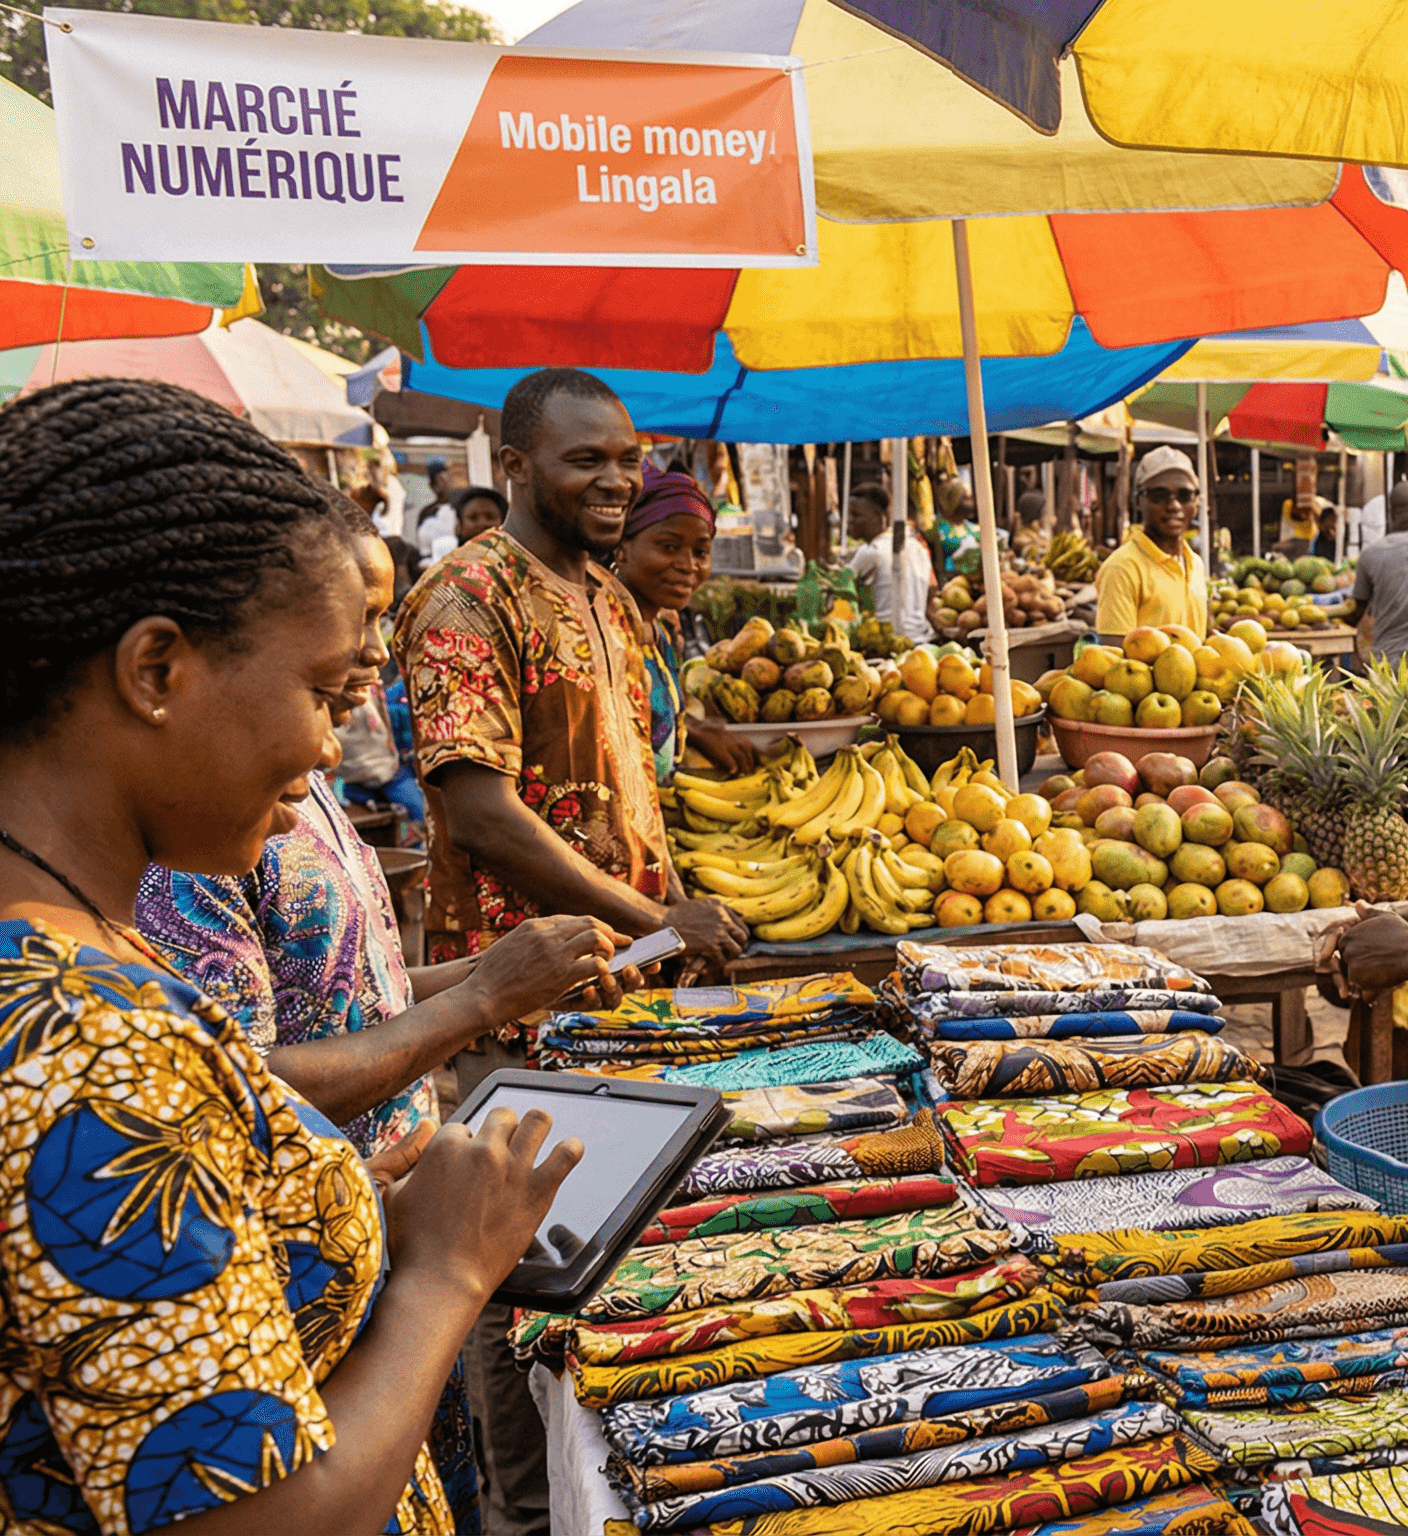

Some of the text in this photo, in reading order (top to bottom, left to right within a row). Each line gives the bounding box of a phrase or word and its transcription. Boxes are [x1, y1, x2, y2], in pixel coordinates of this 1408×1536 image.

[156, 76, 361, 138] MARCHÉ
[498, 111, 632, 153] Mobile
[120, 138, 405, 204] NUMÉRIQUE
[577, 164, 717, 212] Lingala
